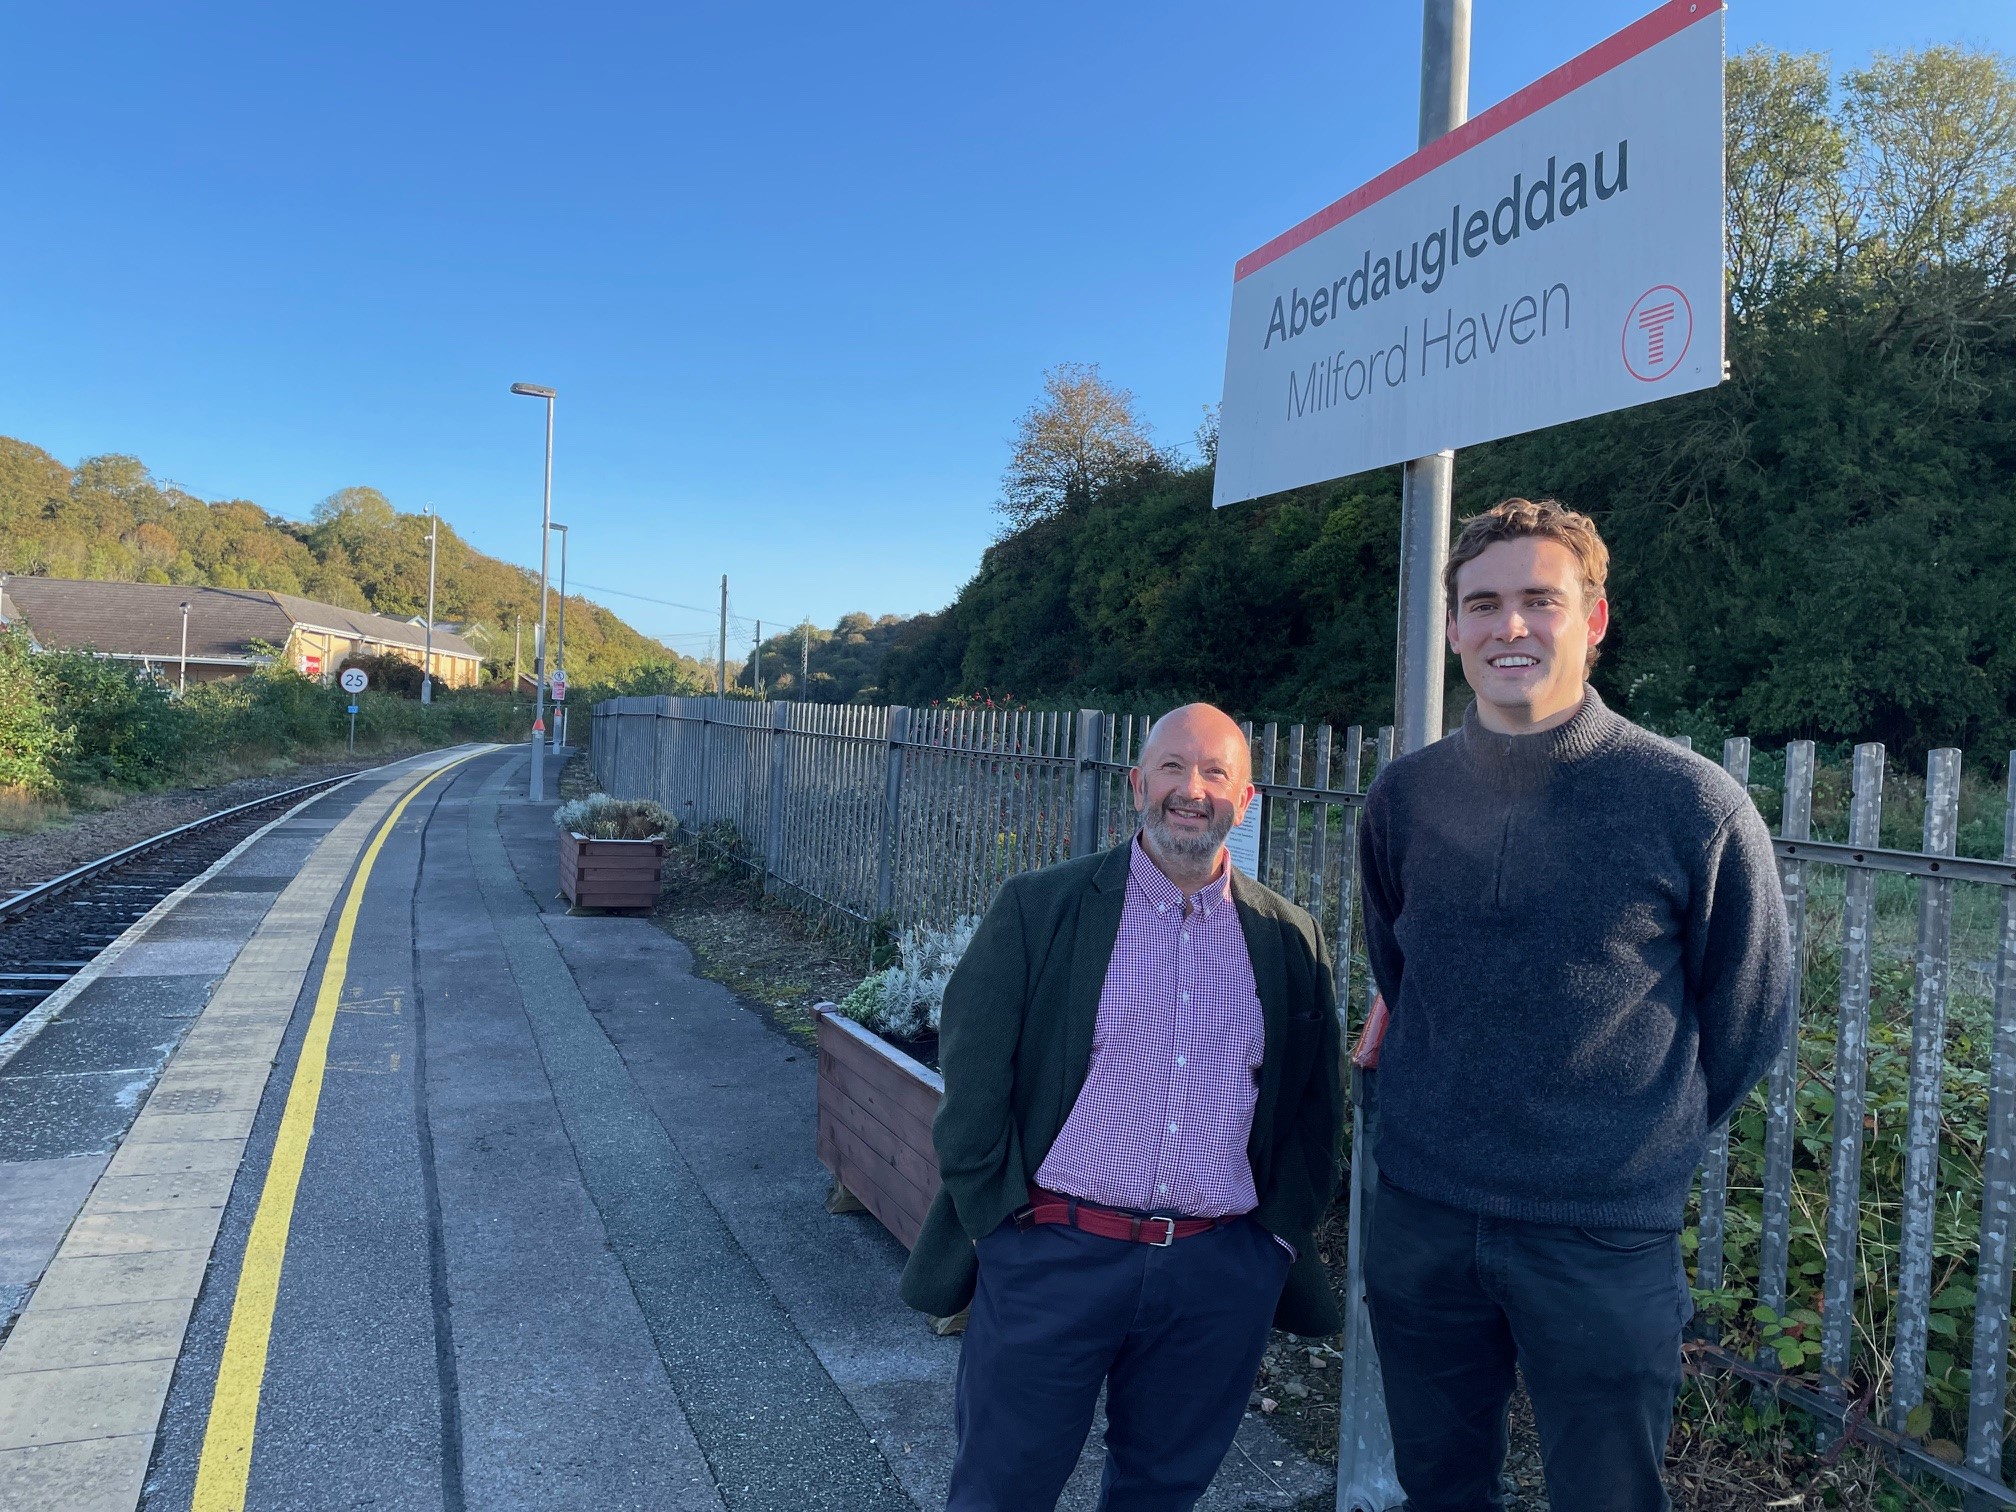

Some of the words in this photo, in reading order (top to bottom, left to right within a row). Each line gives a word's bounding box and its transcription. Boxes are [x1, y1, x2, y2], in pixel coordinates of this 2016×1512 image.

[1263, 139, 1630, 350] Aberdaugleddau
[1287, 327, 1408, 422] Milford
[1421, 283, 1571, 377] Haven
[345, 674, 363, 687] 25
